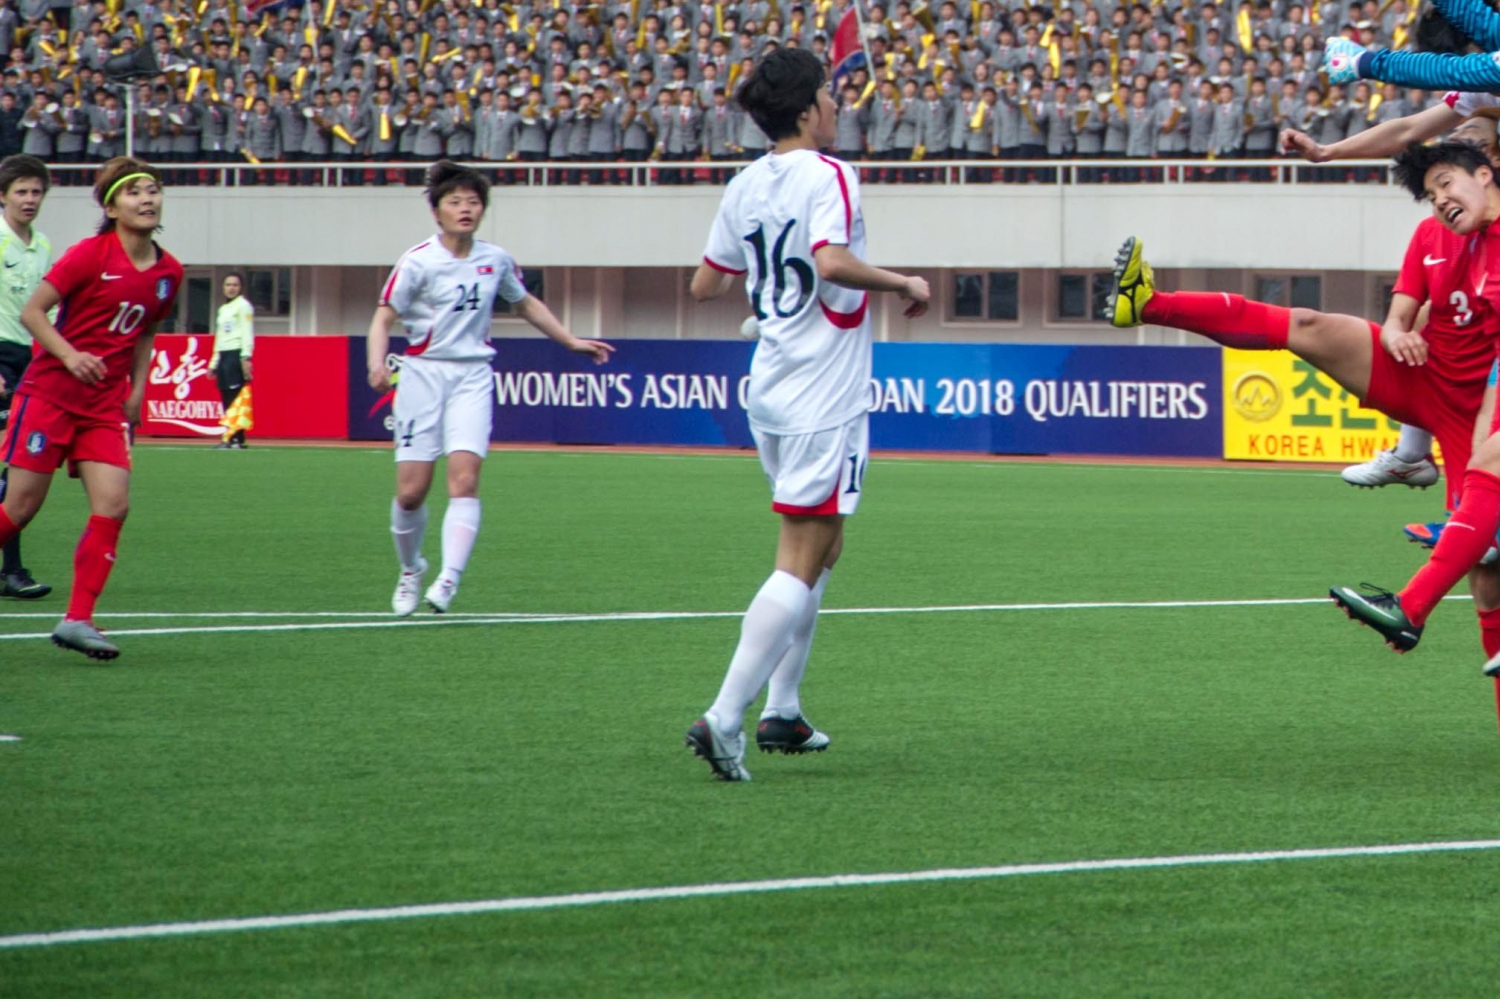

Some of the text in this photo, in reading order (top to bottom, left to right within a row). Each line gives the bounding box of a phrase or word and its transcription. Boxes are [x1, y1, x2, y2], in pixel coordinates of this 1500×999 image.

[743, 218, 815, 321] 16
[452, 282, 481, 312] 24
[1450, 290, 1474, 326] 3
[108, 300, 146, 335] 10
[493, 371, 633, 409] WOMEN'S
[640, 373, 728, 410] ASIAN
[935, 378, 1015, 416] 2018
[1024, 379, 1208, 422] QUALIFIERS
[1248, 434, 1400, 458] KOREA HWA
